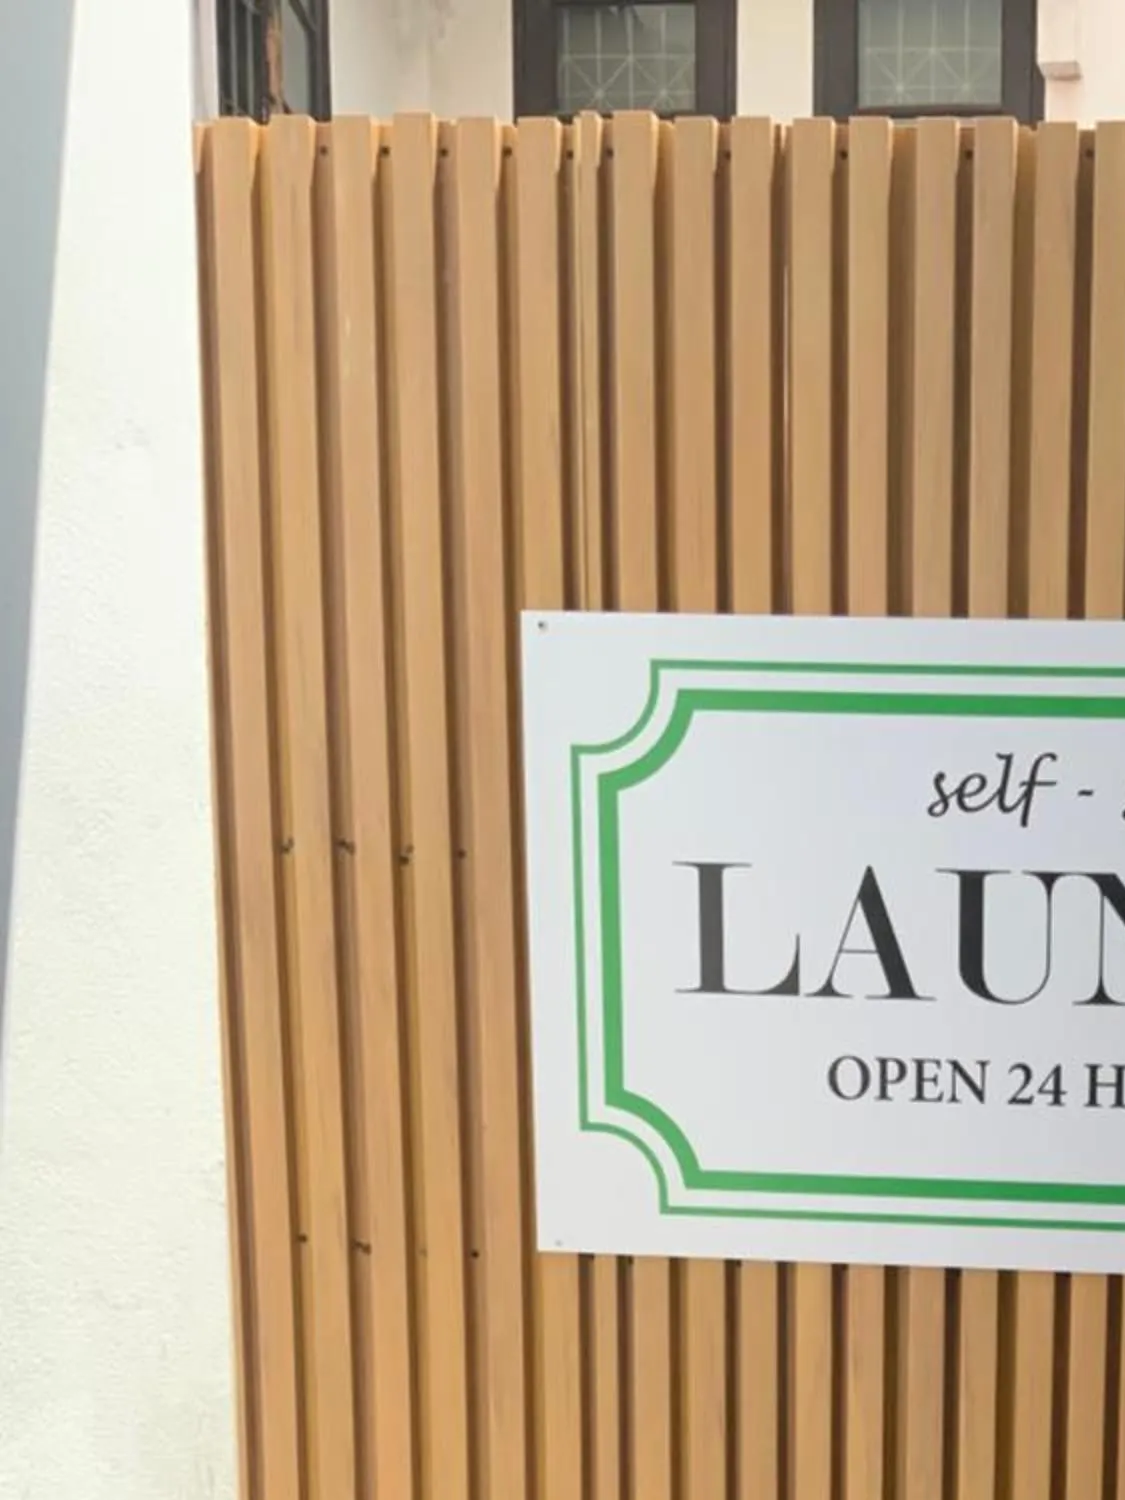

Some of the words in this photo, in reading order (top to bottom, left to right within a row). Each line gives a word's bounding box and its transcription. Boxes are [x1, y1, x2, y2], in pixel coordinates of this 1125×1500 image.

[926, 752, 1059, 828] self
[827, 1054, 990, 1105] OPEN
[1007, 1062, 1068, 1108] 24
